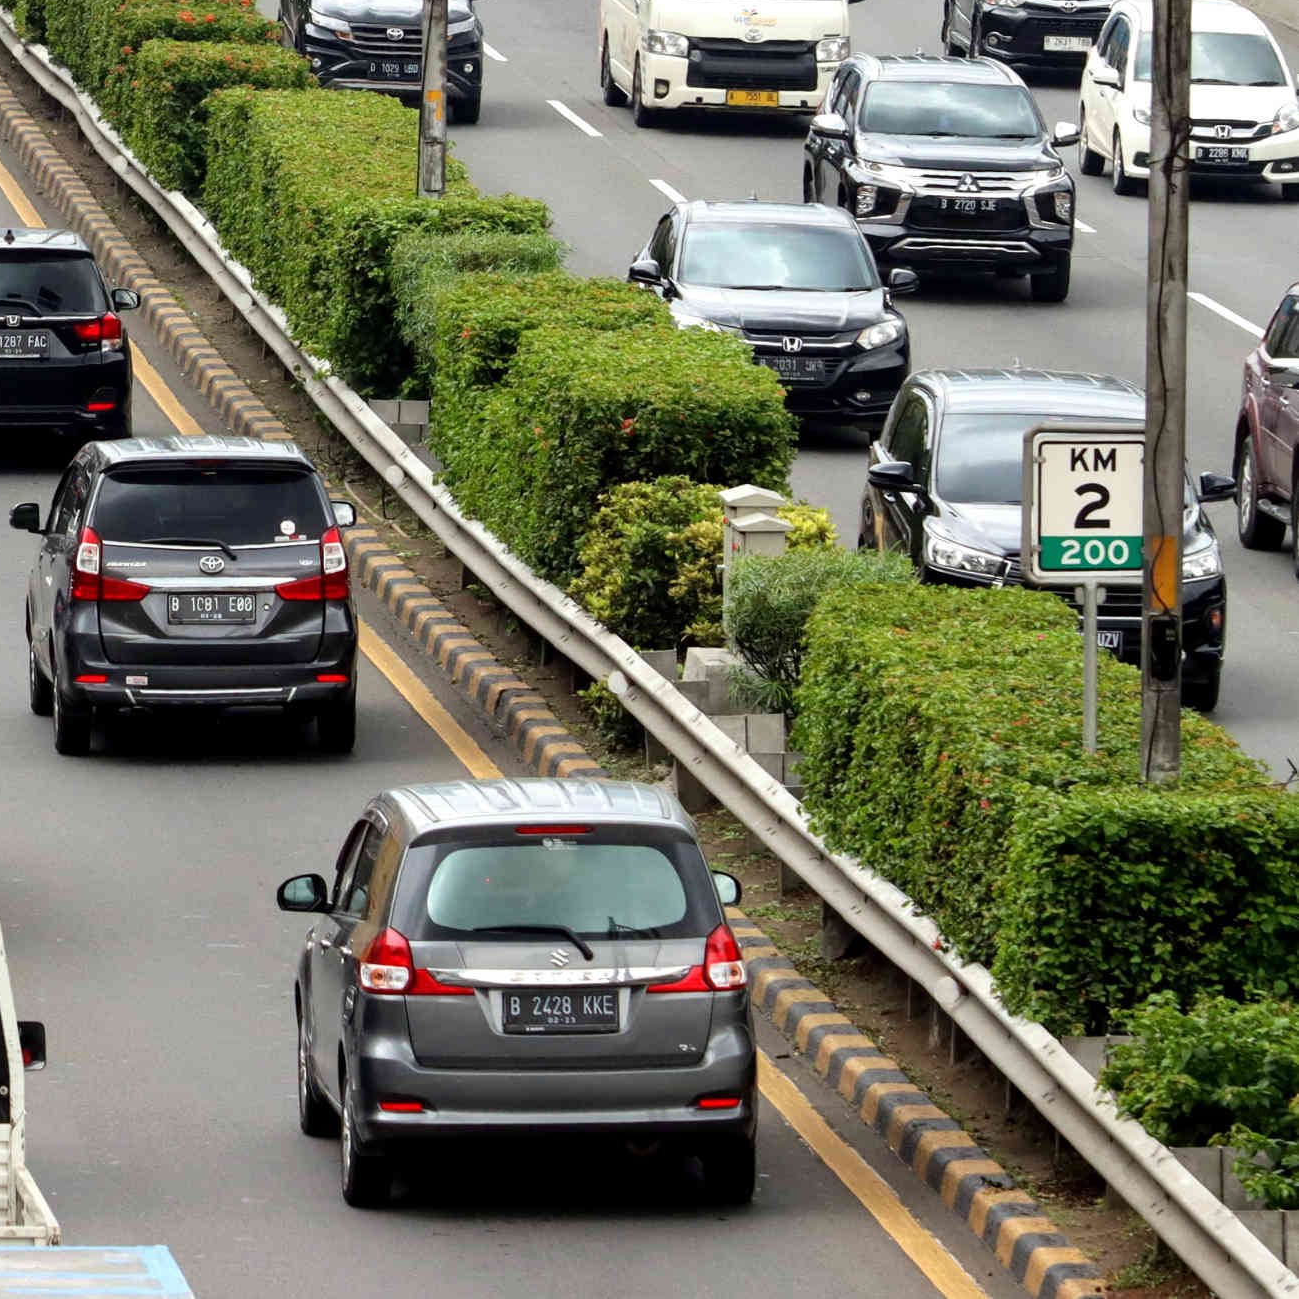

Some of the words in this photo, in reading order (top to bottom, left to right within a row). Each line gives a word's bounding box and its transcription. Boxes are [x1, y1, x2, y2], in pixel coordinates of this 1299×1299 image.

[0, 337, 23, 348] 1287
[27, 337, 47, 348] FAC
[1069, 448, 1117, 473] KM
[1073, 484, 1112, 530] 2
[1060, 540, 1129, 566] 200
[172, 598, 180, 612] B
[191, 598, 219, 612] 1081
[1097, 632, 1119, 647] UZV
[510, 997, 521, 1016] B
[532, 996, 572, 1016] 2428
[582, 995, 614, 1015] KKE
